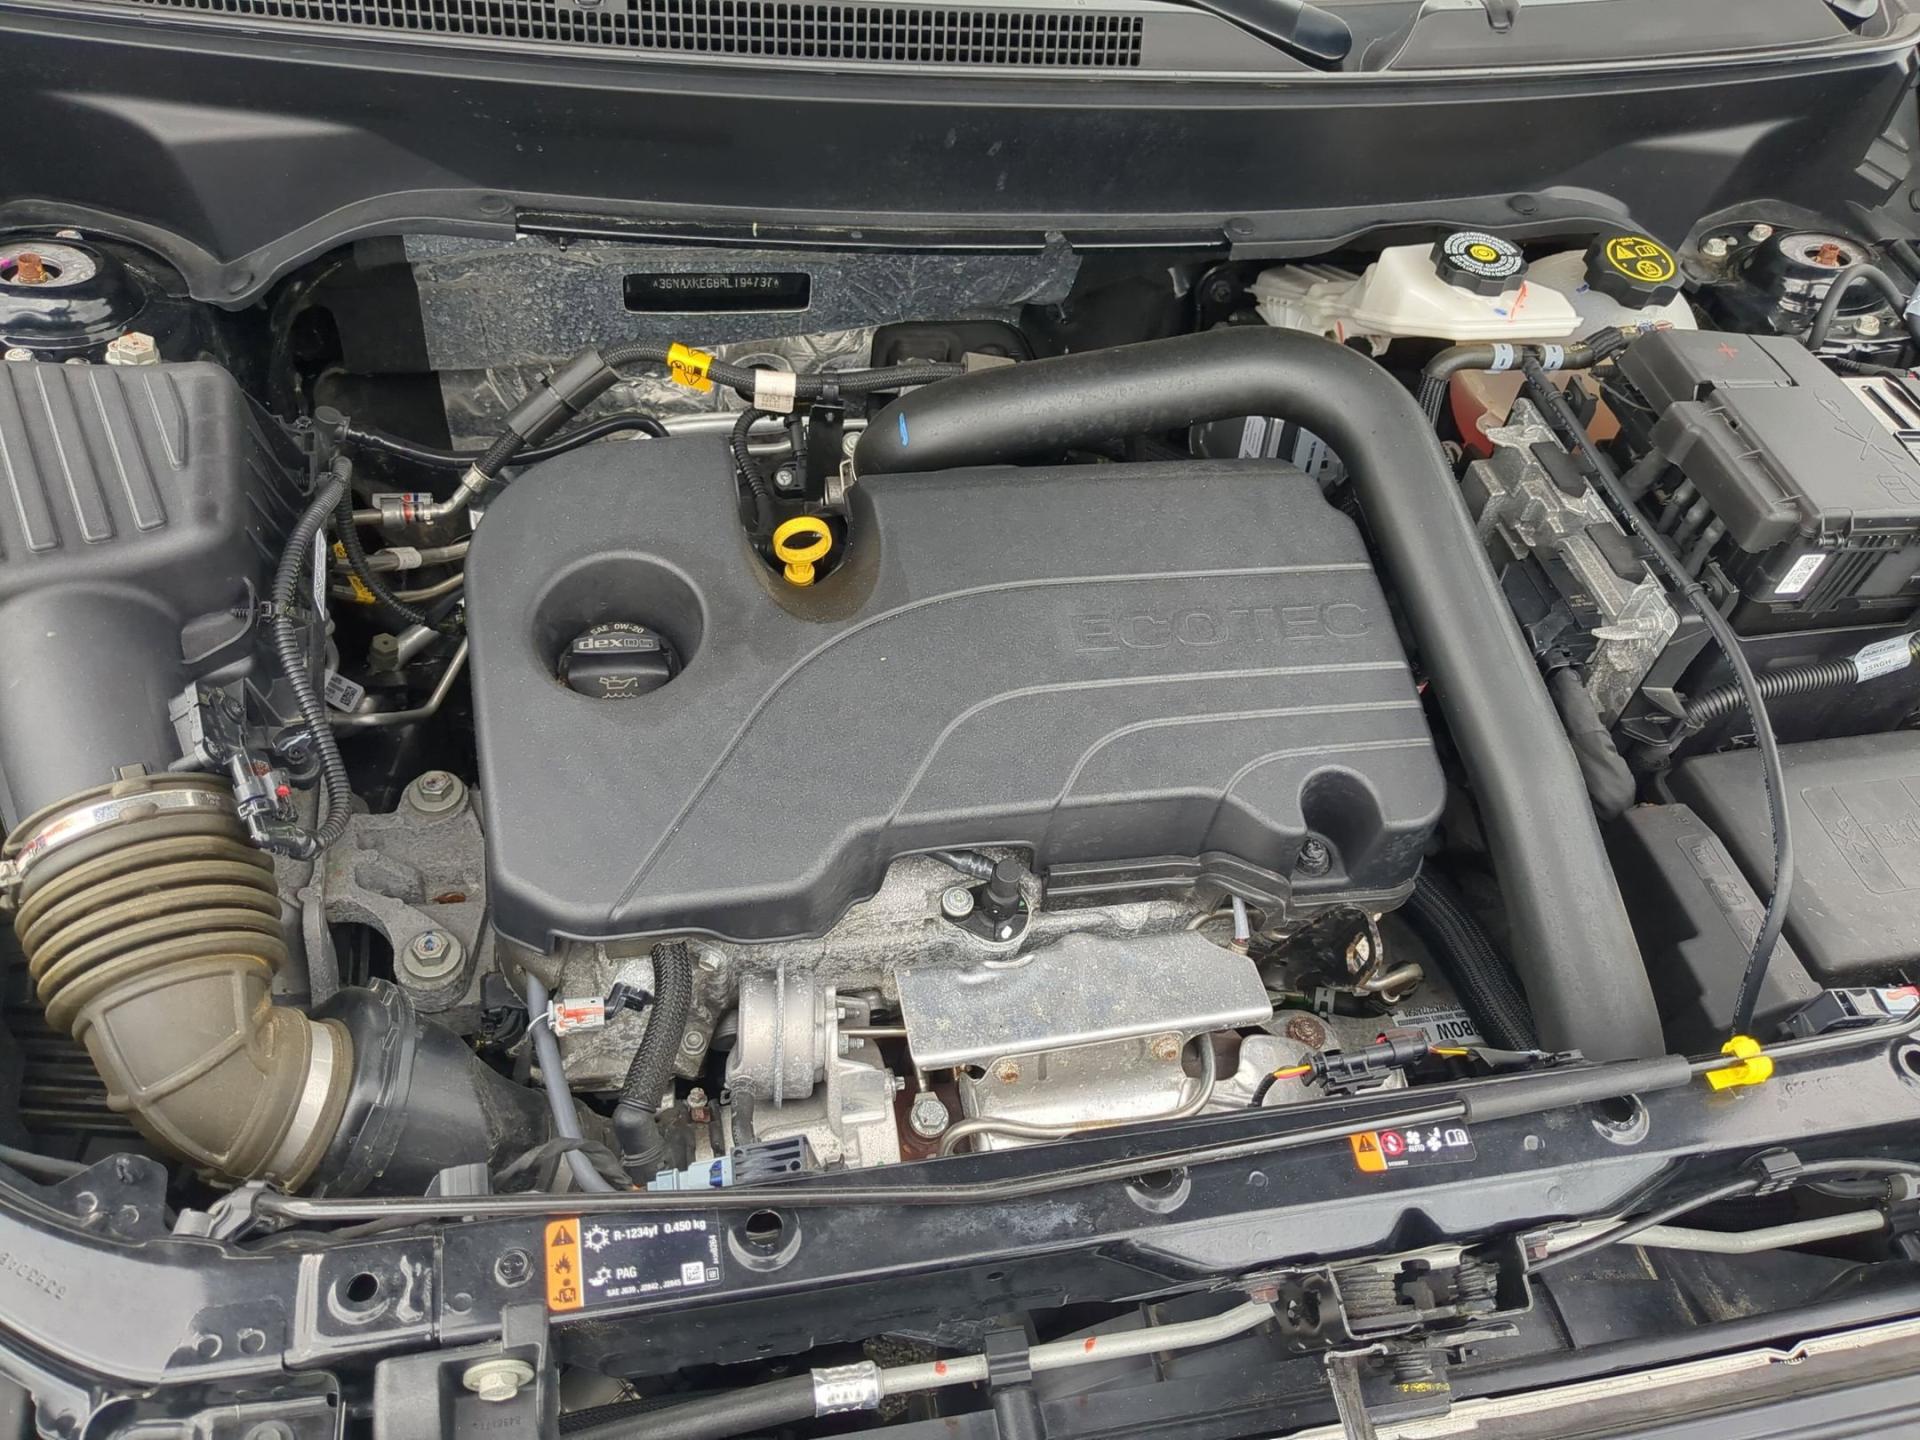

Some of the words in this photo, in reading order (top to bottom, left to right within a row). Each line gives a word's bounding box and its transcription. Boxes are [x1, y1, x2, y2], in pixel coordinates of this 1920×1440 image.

[590, 624, 610, 636] SAE
[614, 623, 645, 634] 0W-20
[1071, 603, 1370, 652] ECOTEC
[613, 1225, 659, 1242] R-1234yf
[664, 1221, 692, 1235] 0.450
[693, 1219, 707, 1232] kg
[615, 1267, 637, 1279] PAG
